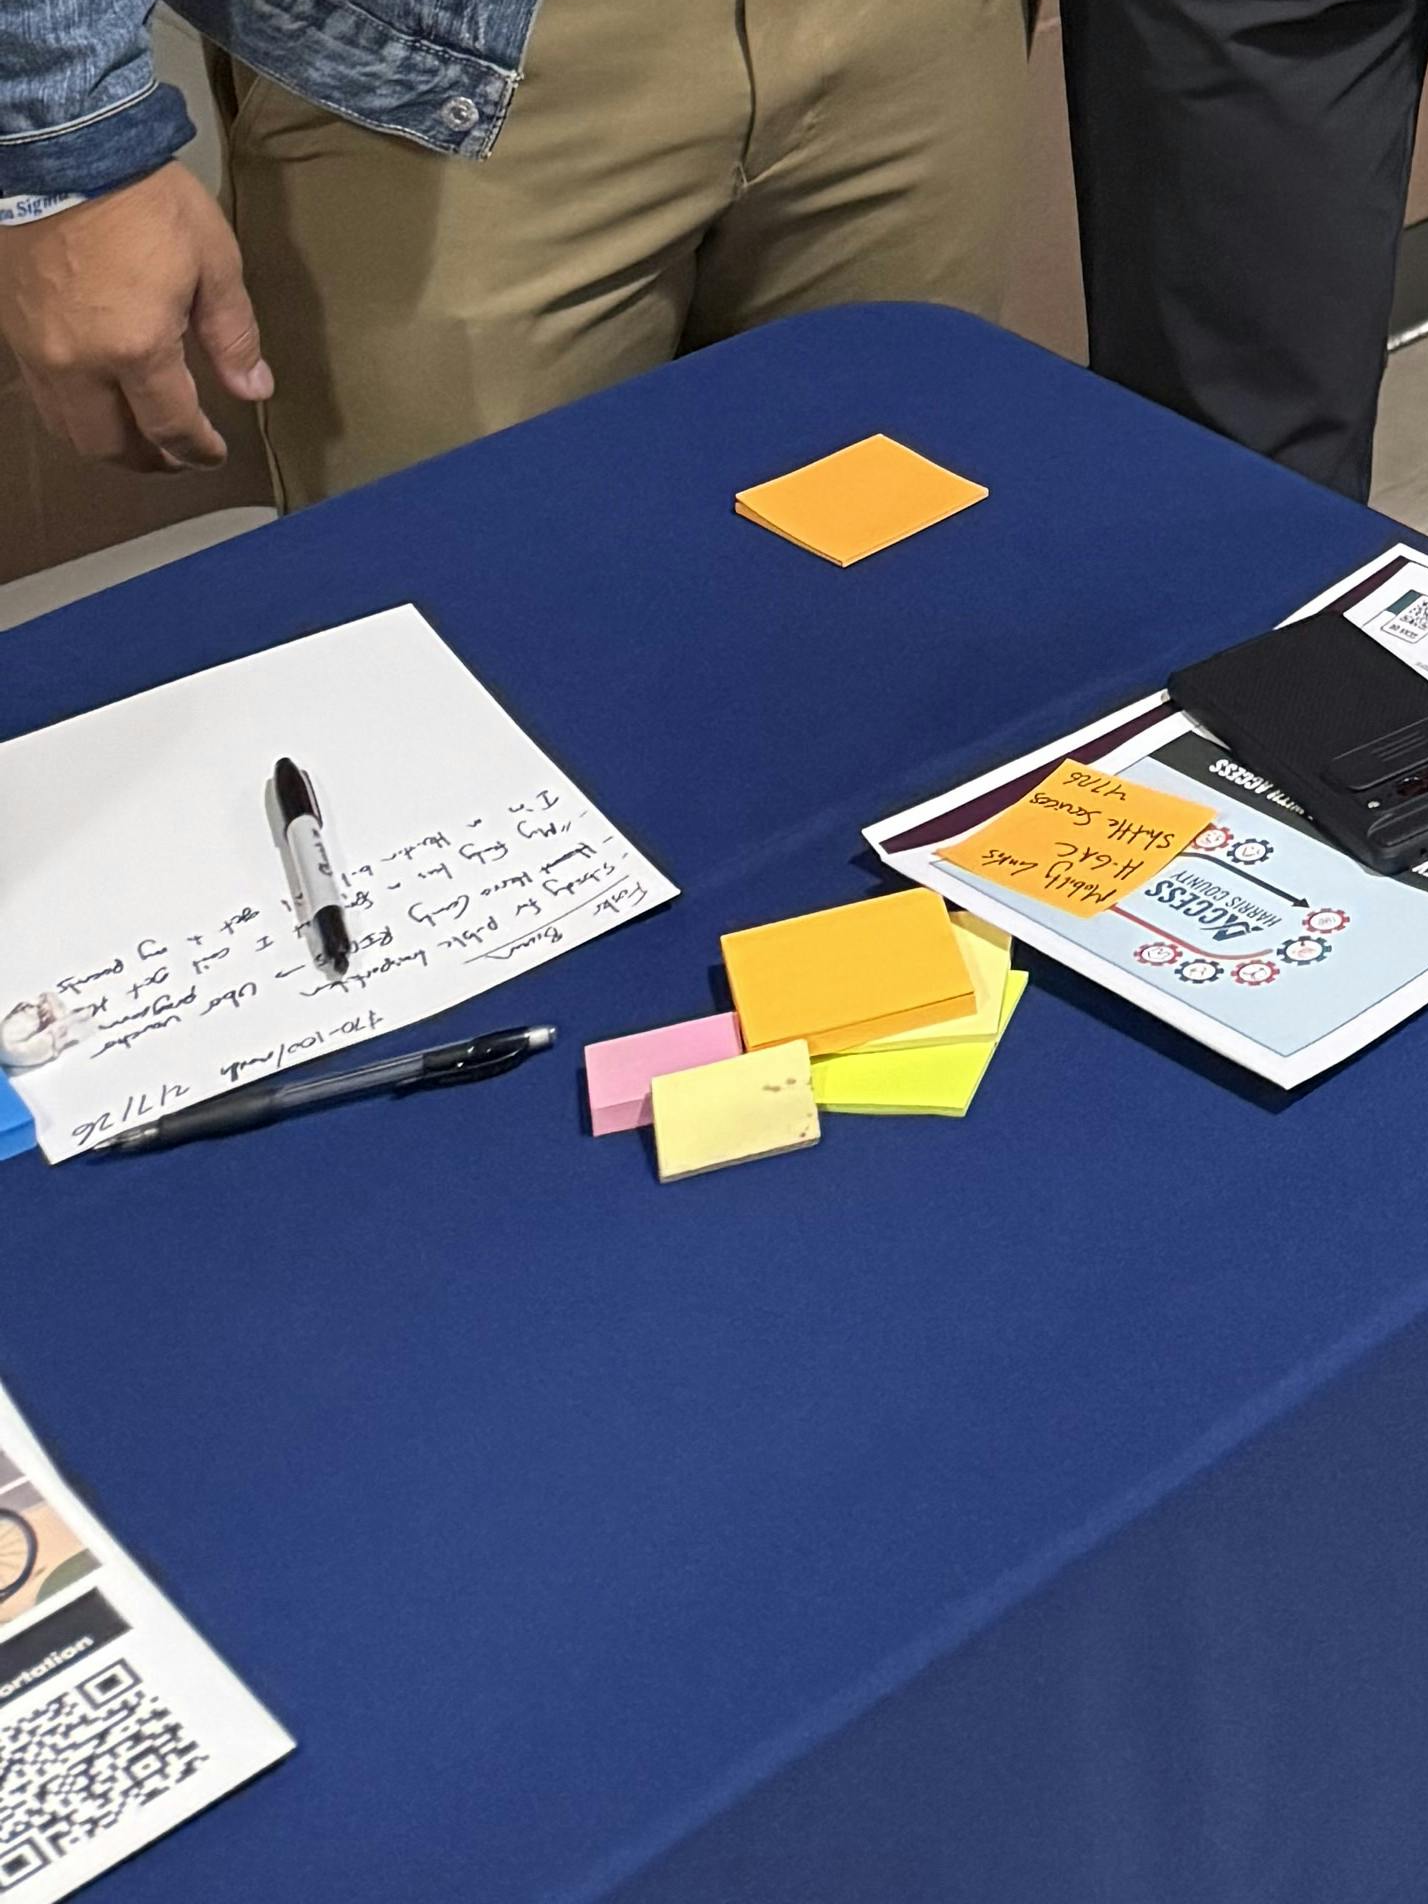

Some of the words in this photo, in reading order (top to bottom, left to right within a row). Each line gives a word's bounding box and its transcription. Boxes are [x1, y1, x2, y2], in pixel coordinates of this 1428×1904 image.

[1209, 760, 1272, 793] ACCESS
[1029, 780, 1102, 826] Services
[1108, 819, 1174, 851] Shuttle
[1055, 842, 1144, 880] H-GAC
[1170, 871, 1230, 901] COUNTY
[1144, 880, 1264, 941] ACCESS
[1225, 897, 1282, 927] HARRIS
[192, 982, 256, 1015] Uber
[72, 1085, 190, 1146] 2/7/26
[0, 1635, 94, 1698] ortation
